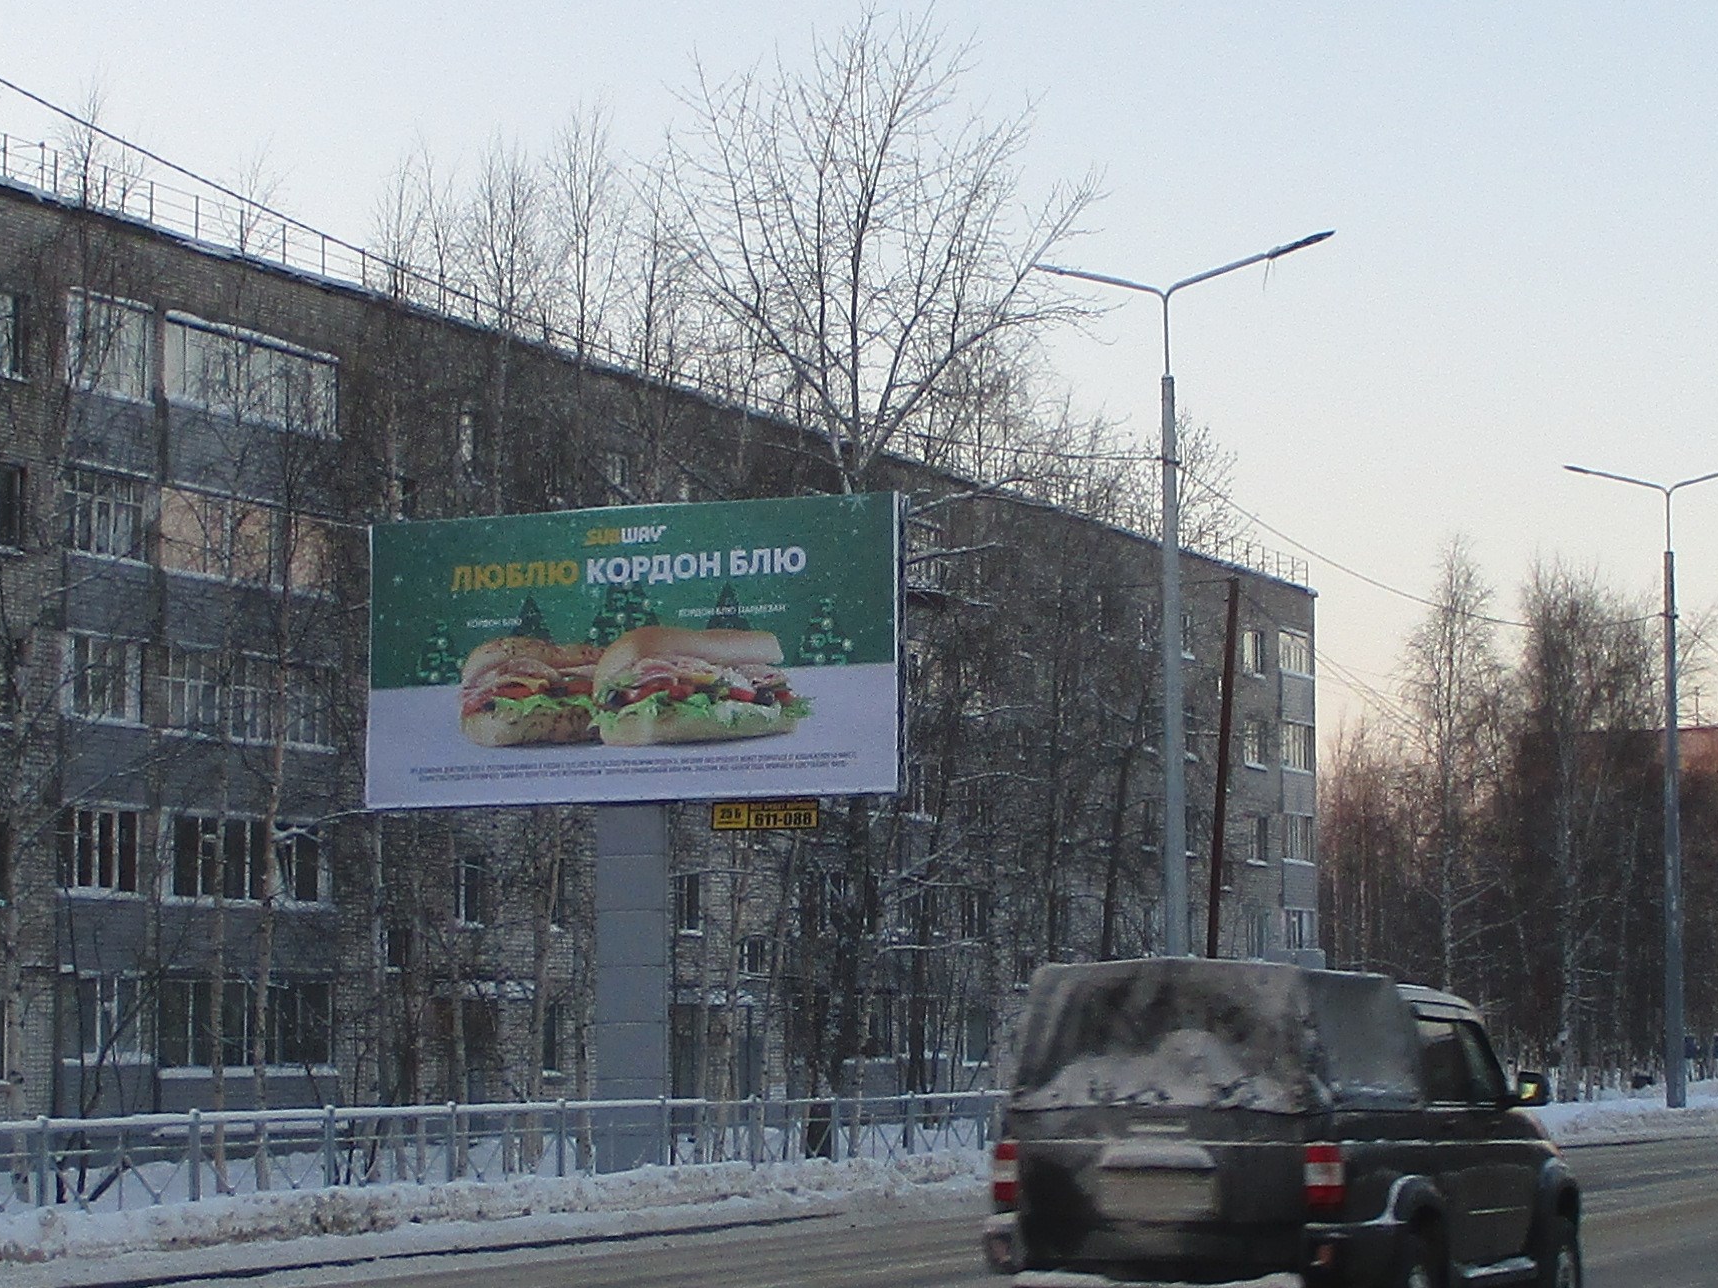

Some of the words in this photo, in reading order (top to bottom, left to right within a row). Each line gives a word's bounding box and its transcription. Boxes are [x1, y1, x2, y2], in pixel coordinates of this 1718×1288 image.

[583, 525, 667, 547] SUBWAY
[451, 560, 580, 592] ЛЮБЛЮ
[586, 551, 721, 585] КОРДОН
[730, 546, 806, 576] БЛЮ
